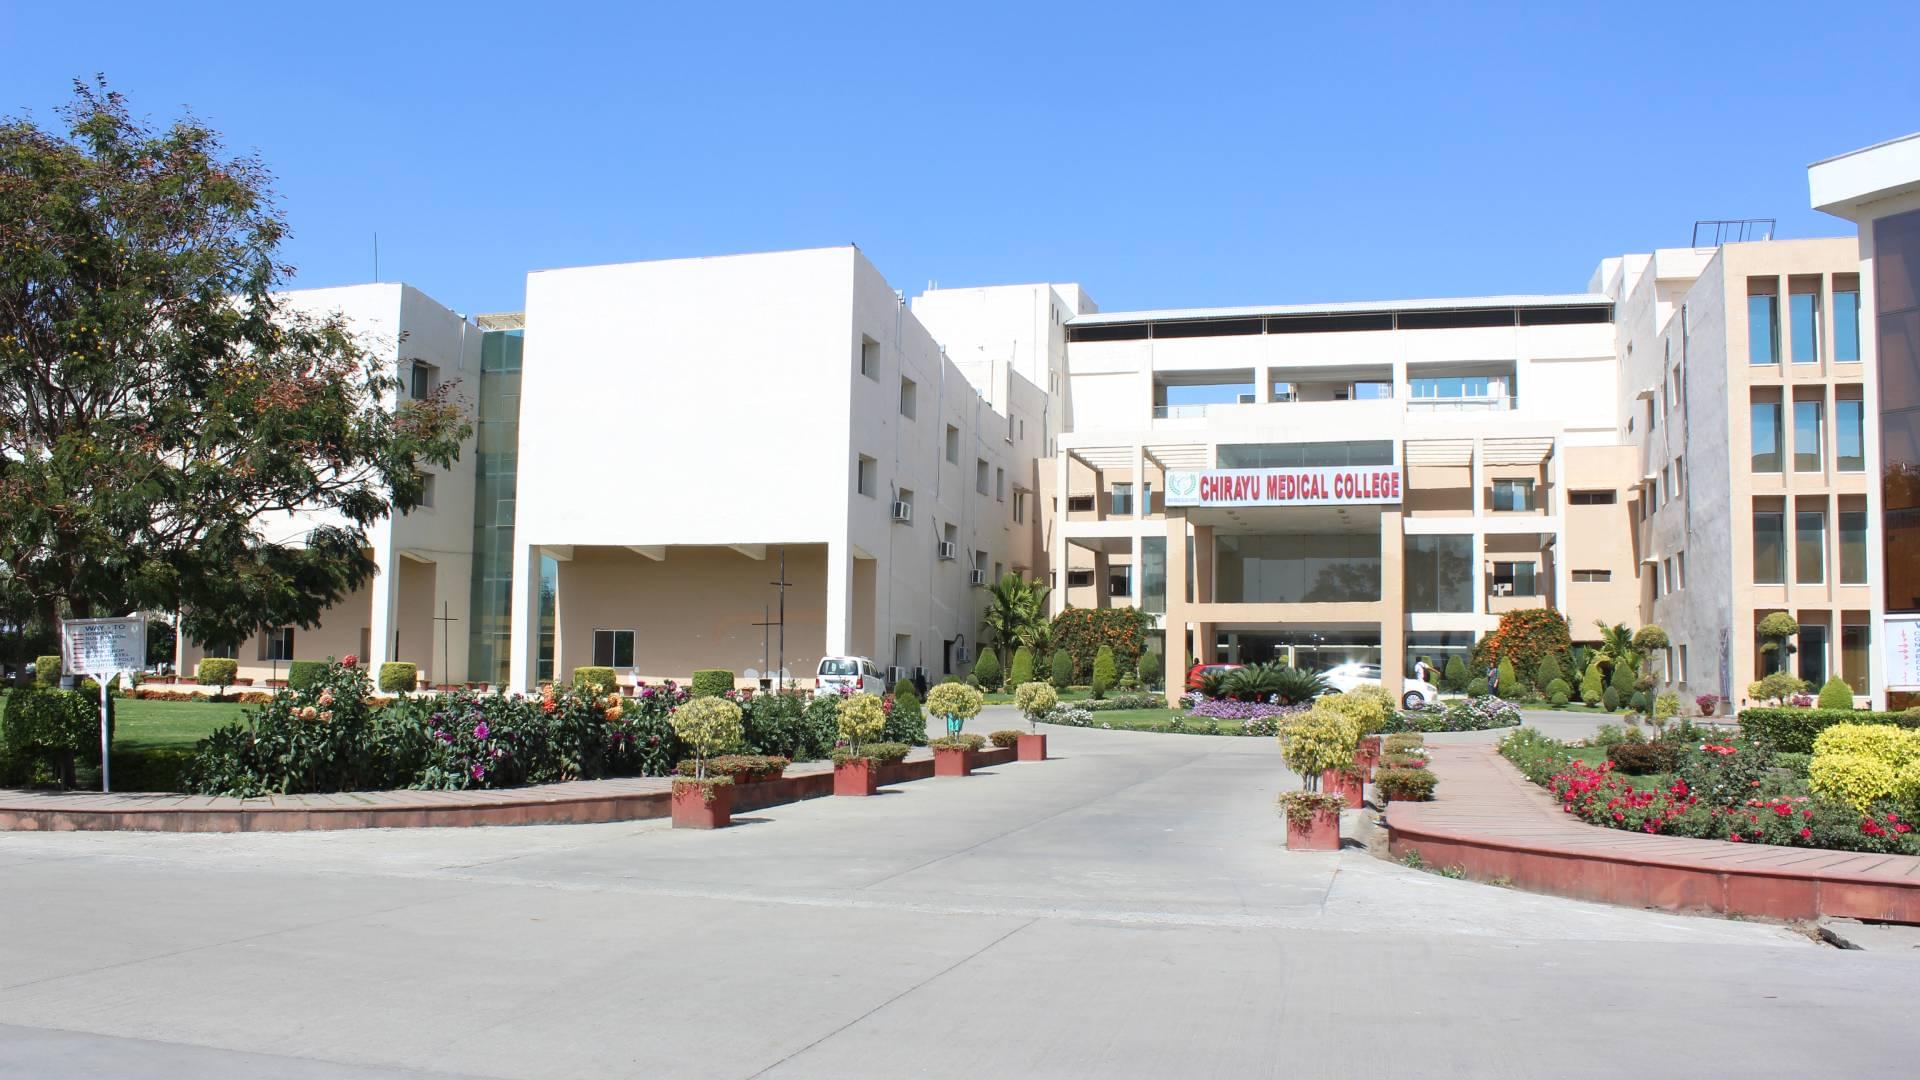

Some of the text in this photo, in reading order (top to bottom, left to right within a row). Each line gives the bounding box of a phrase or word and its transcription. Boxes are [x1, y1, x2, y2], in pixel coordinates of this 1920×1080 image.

[1200, 472, 1399, 501] CHIRAYU MEDICAL COLLEGE
